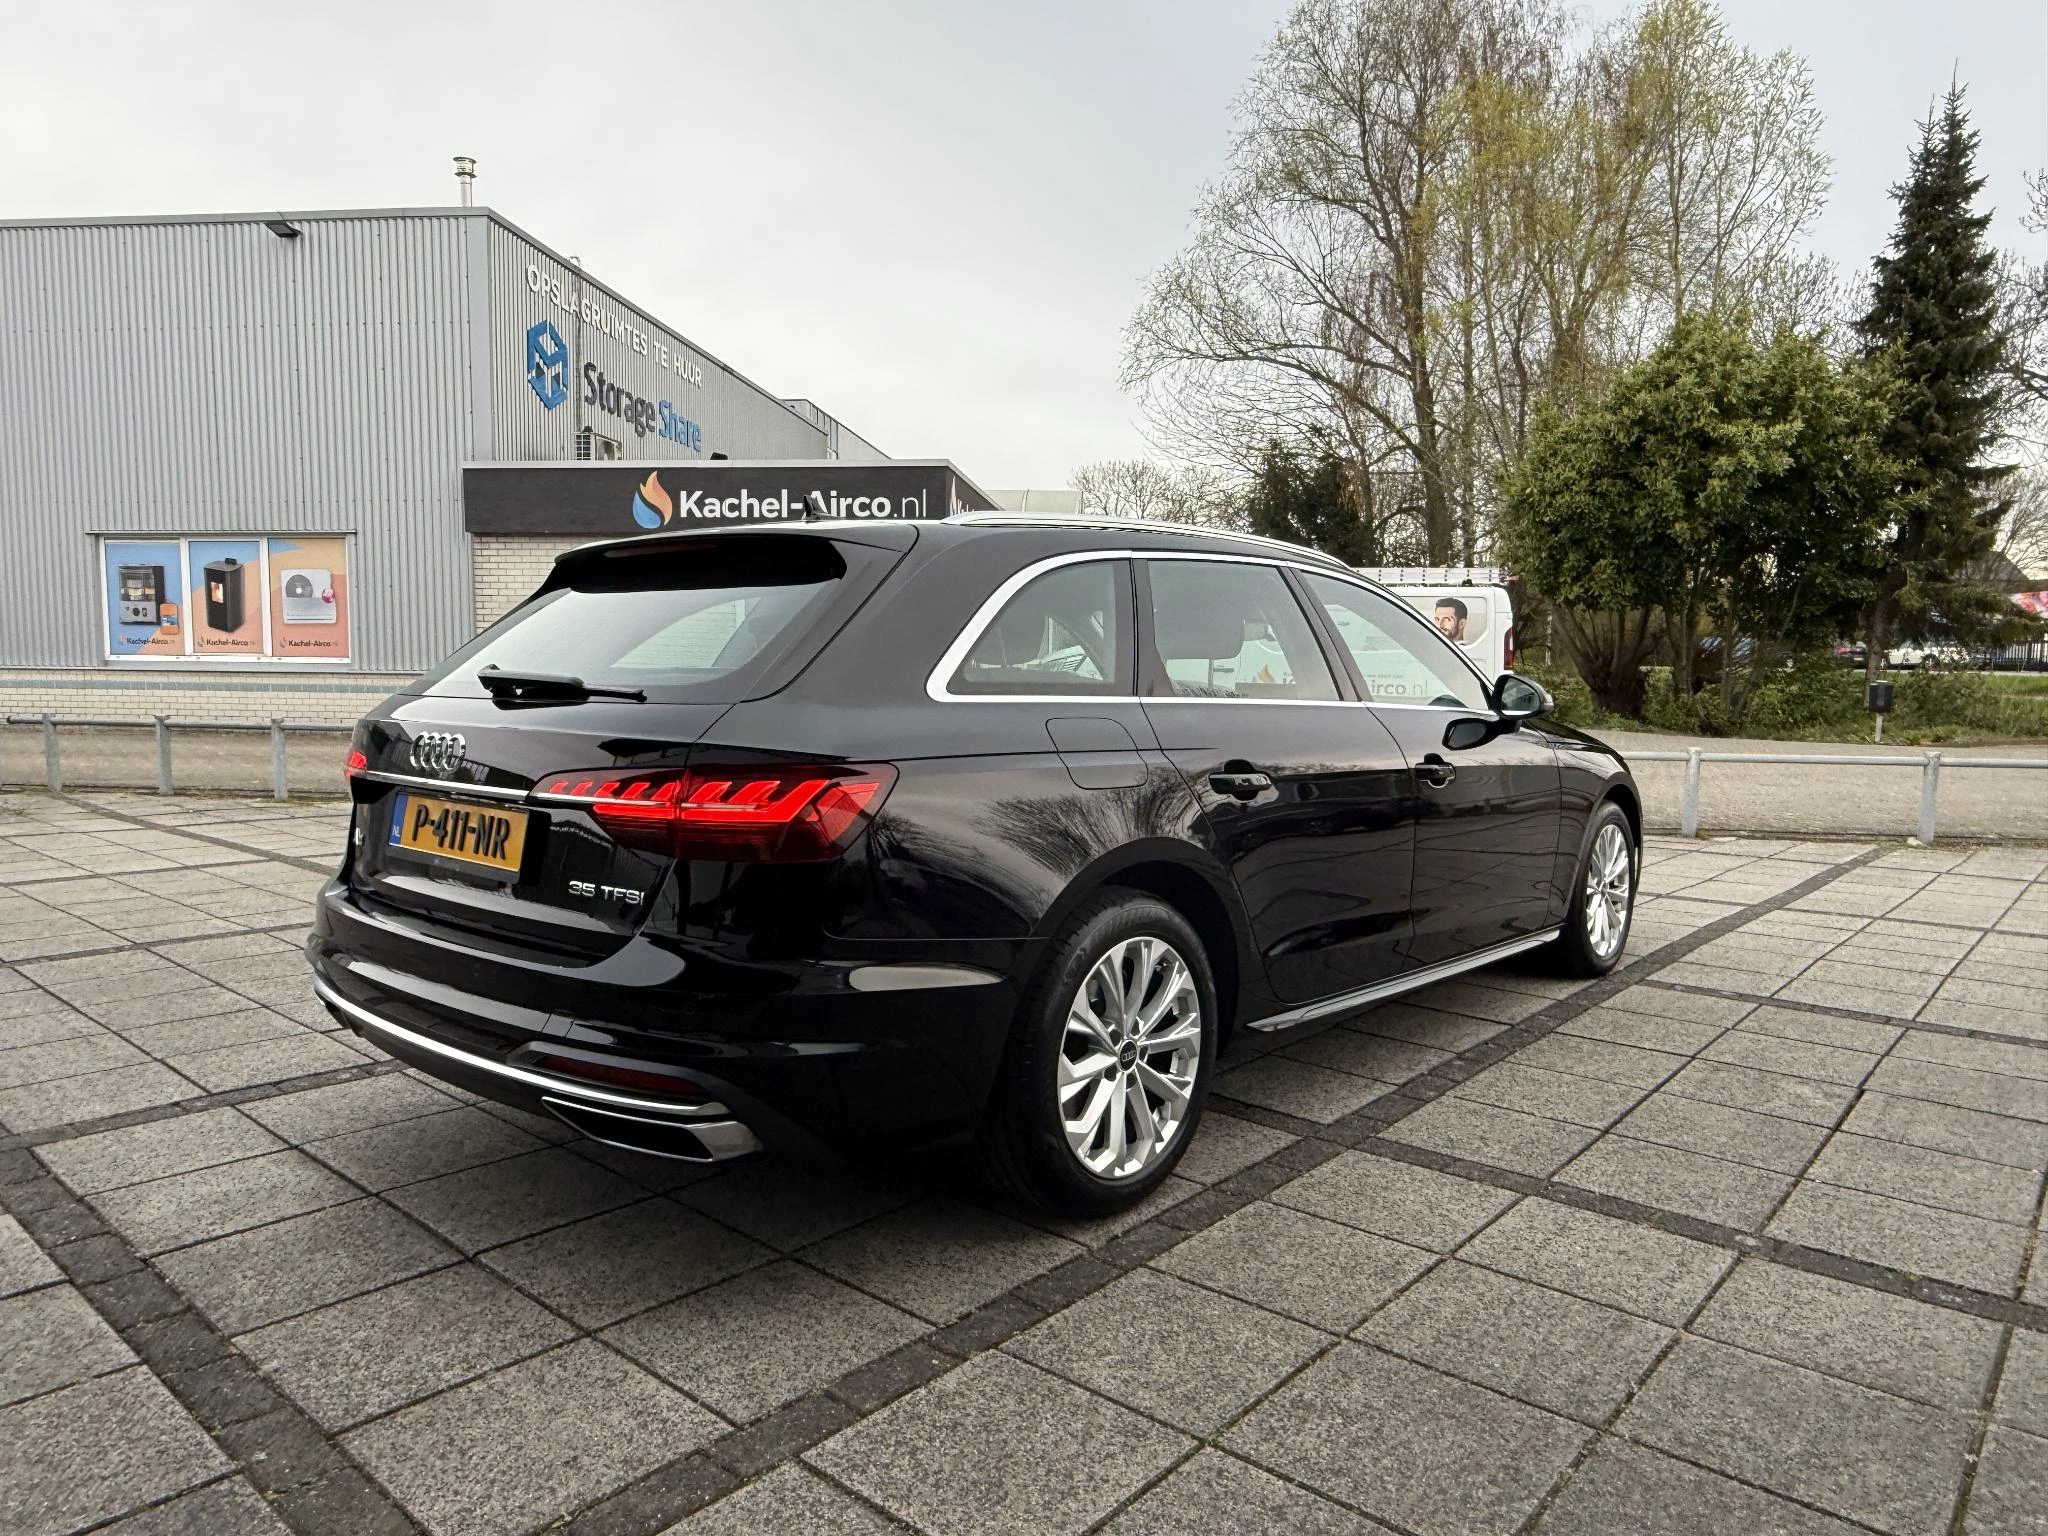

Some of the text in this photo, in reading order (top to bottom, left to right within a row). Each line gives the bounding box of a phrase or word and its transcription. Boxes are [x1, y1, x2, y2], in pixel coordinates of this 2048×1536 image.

[653, 341, 668, 369] TE
[673, 352, 702, 389] HUUR
[680, 488, 927, 519] Kachel-Airco.nl
[391, 825, 401, 838] NL
[411, 803, 511, 861] P-411-NR
[568, 880, 645, 907] 35 TFSI
